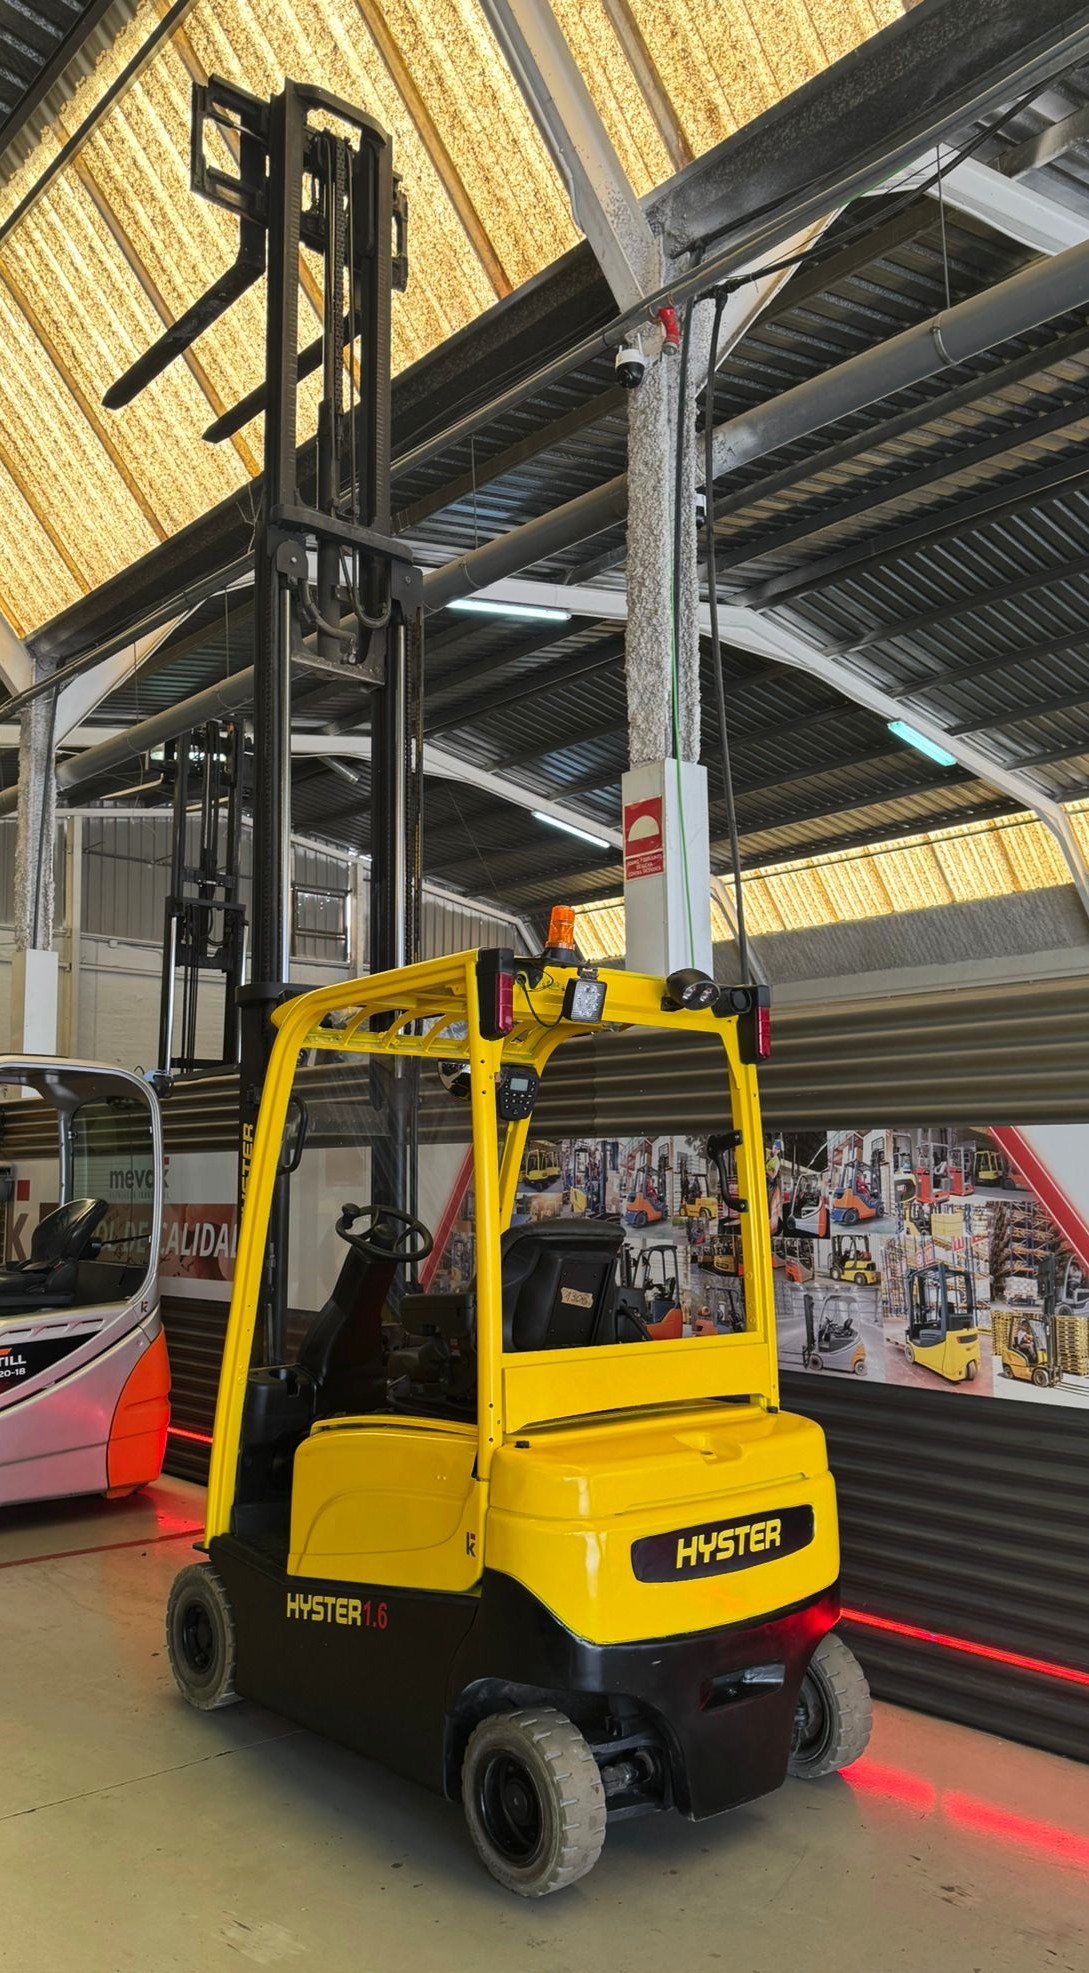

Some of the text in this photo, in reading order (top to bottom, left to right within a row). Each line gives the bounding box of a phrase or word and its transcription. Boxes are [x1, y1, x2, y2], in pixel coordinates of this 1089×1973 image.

[159, 1221, 238, 1259] ALIDA
[0, 1354, 27, 1367] TILL
[676, 1518, 782, 1569] HYSTER
[286, 1593, 388, 1630] HYSTER 1.6
